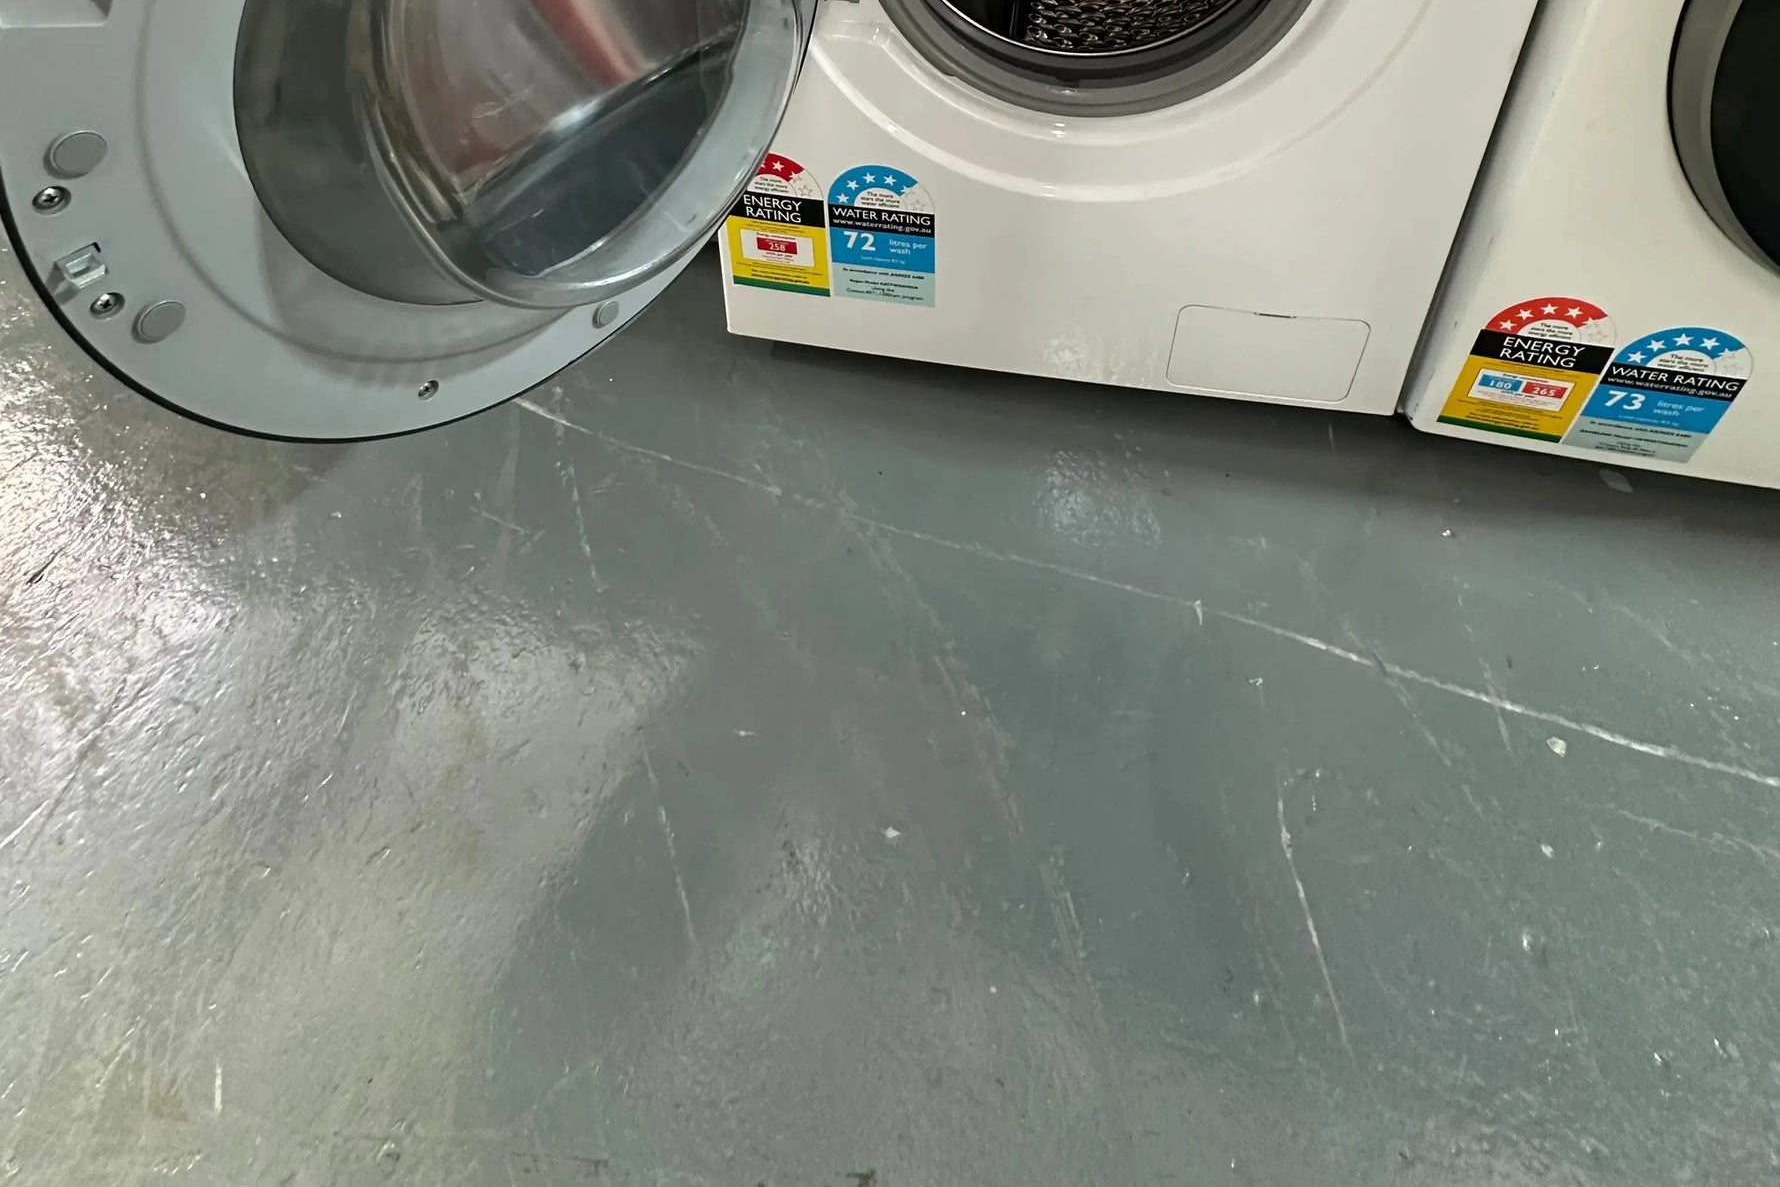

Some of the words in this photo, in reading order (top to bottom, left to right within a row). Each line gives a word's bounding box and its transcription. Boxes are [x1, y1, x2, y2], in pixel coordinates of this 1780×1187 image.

[743, 194, 802, 211] ENERGY
[745, 206, 802, 223] RATING
[832, 207, 878, 221] WATER
[881, 212, 931, 226] RATING
[832, 218, 932, 234] www.waterrating.gov.au
[768, 242, 786, 251] 258
[843, 230, 876, 252] 72
[889, 239, 911, 248] litres
[912, 242, 928, 250] per
[889, 247, 911, 255] wash
[1503, 336, 1586, 357] ENERGY
[1499, 348, 1576, 368] RATING
[1607, 376, 1733, 398] www.waterrating.gov.au
[1612, 366, 1668, 382] WATER
[1673, 375, 1740, 392] RATING
[1604, 390, 1646, 410] 73
[1685, 405, 1705, 413] per
